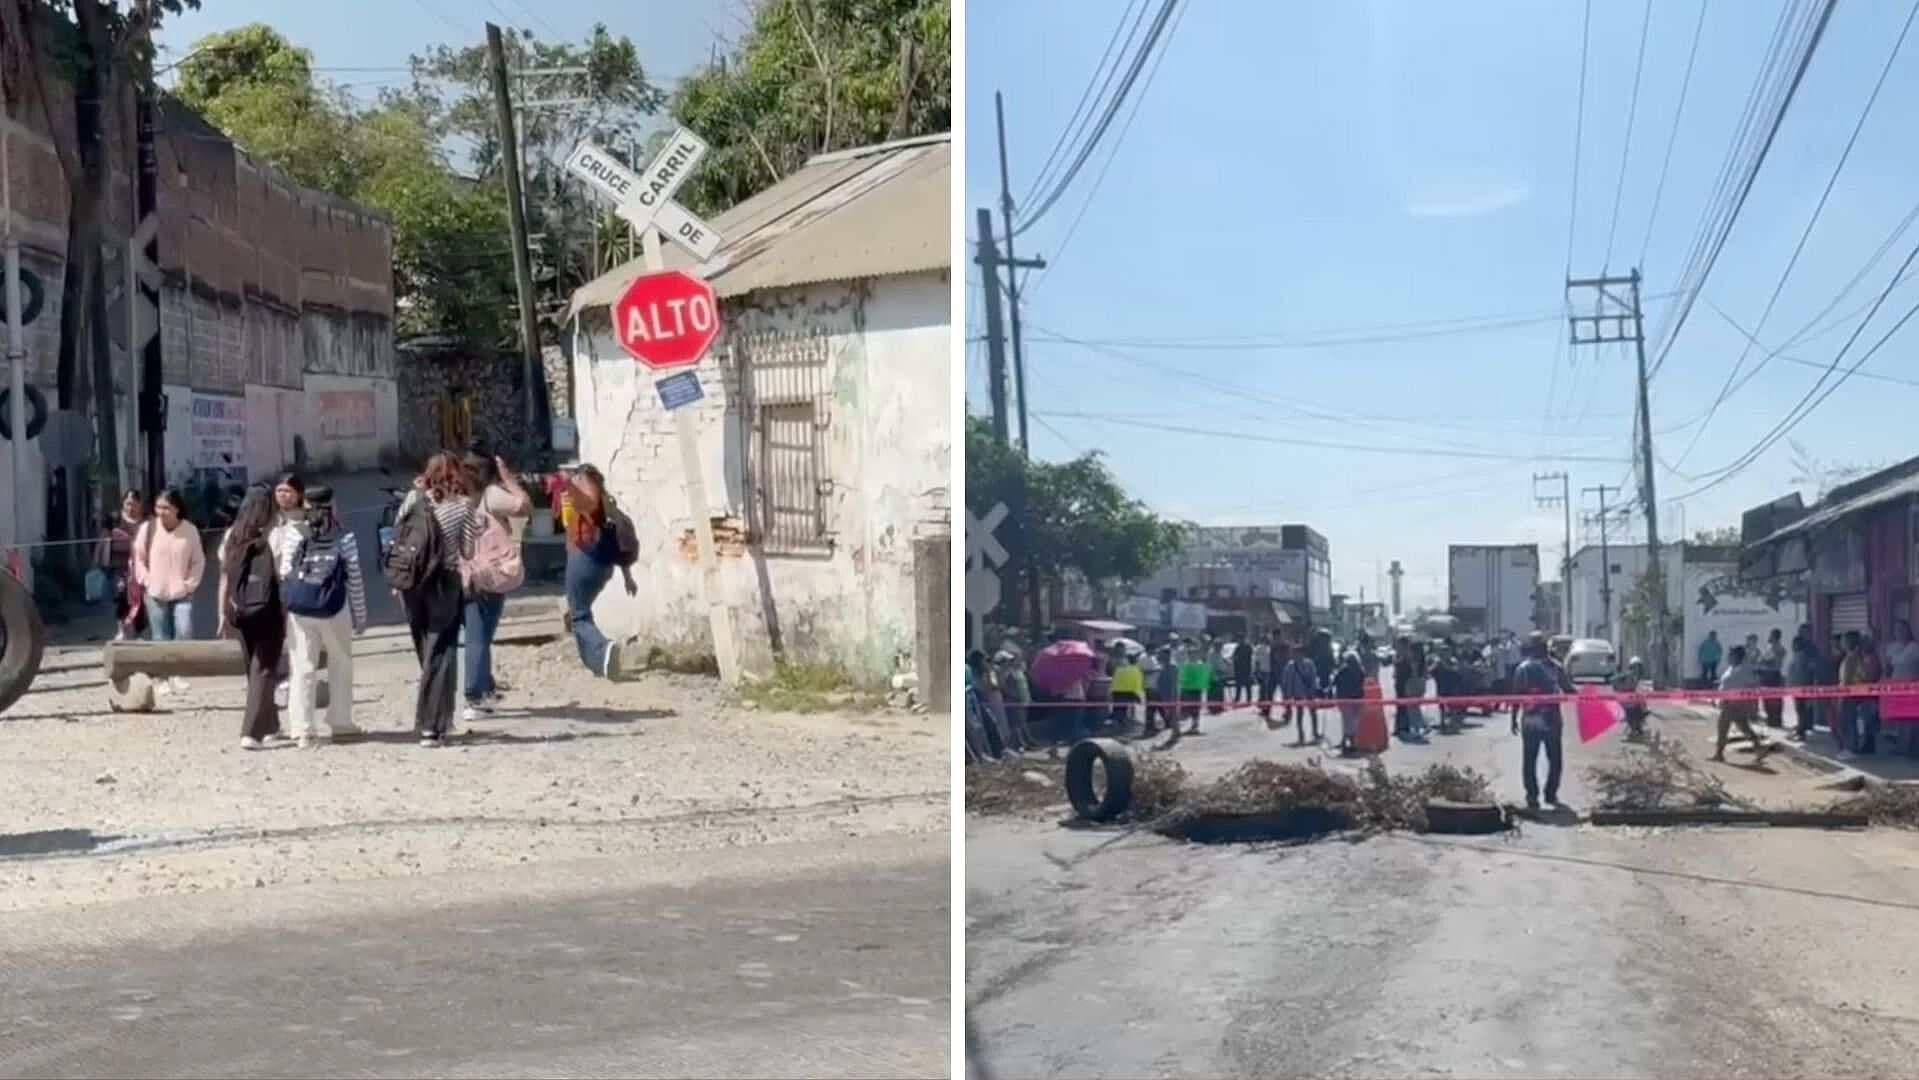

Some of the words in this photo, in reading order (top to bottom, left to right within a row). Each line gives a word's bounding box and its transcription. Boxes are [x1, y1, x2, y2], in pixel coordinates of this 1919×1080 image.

[579, 153, 631, 196] CRUCE
[679, 221, 705, 245] DE
[639, 142, 697, 207] CARRIL
[627, 296, 711, 345] ALTO
